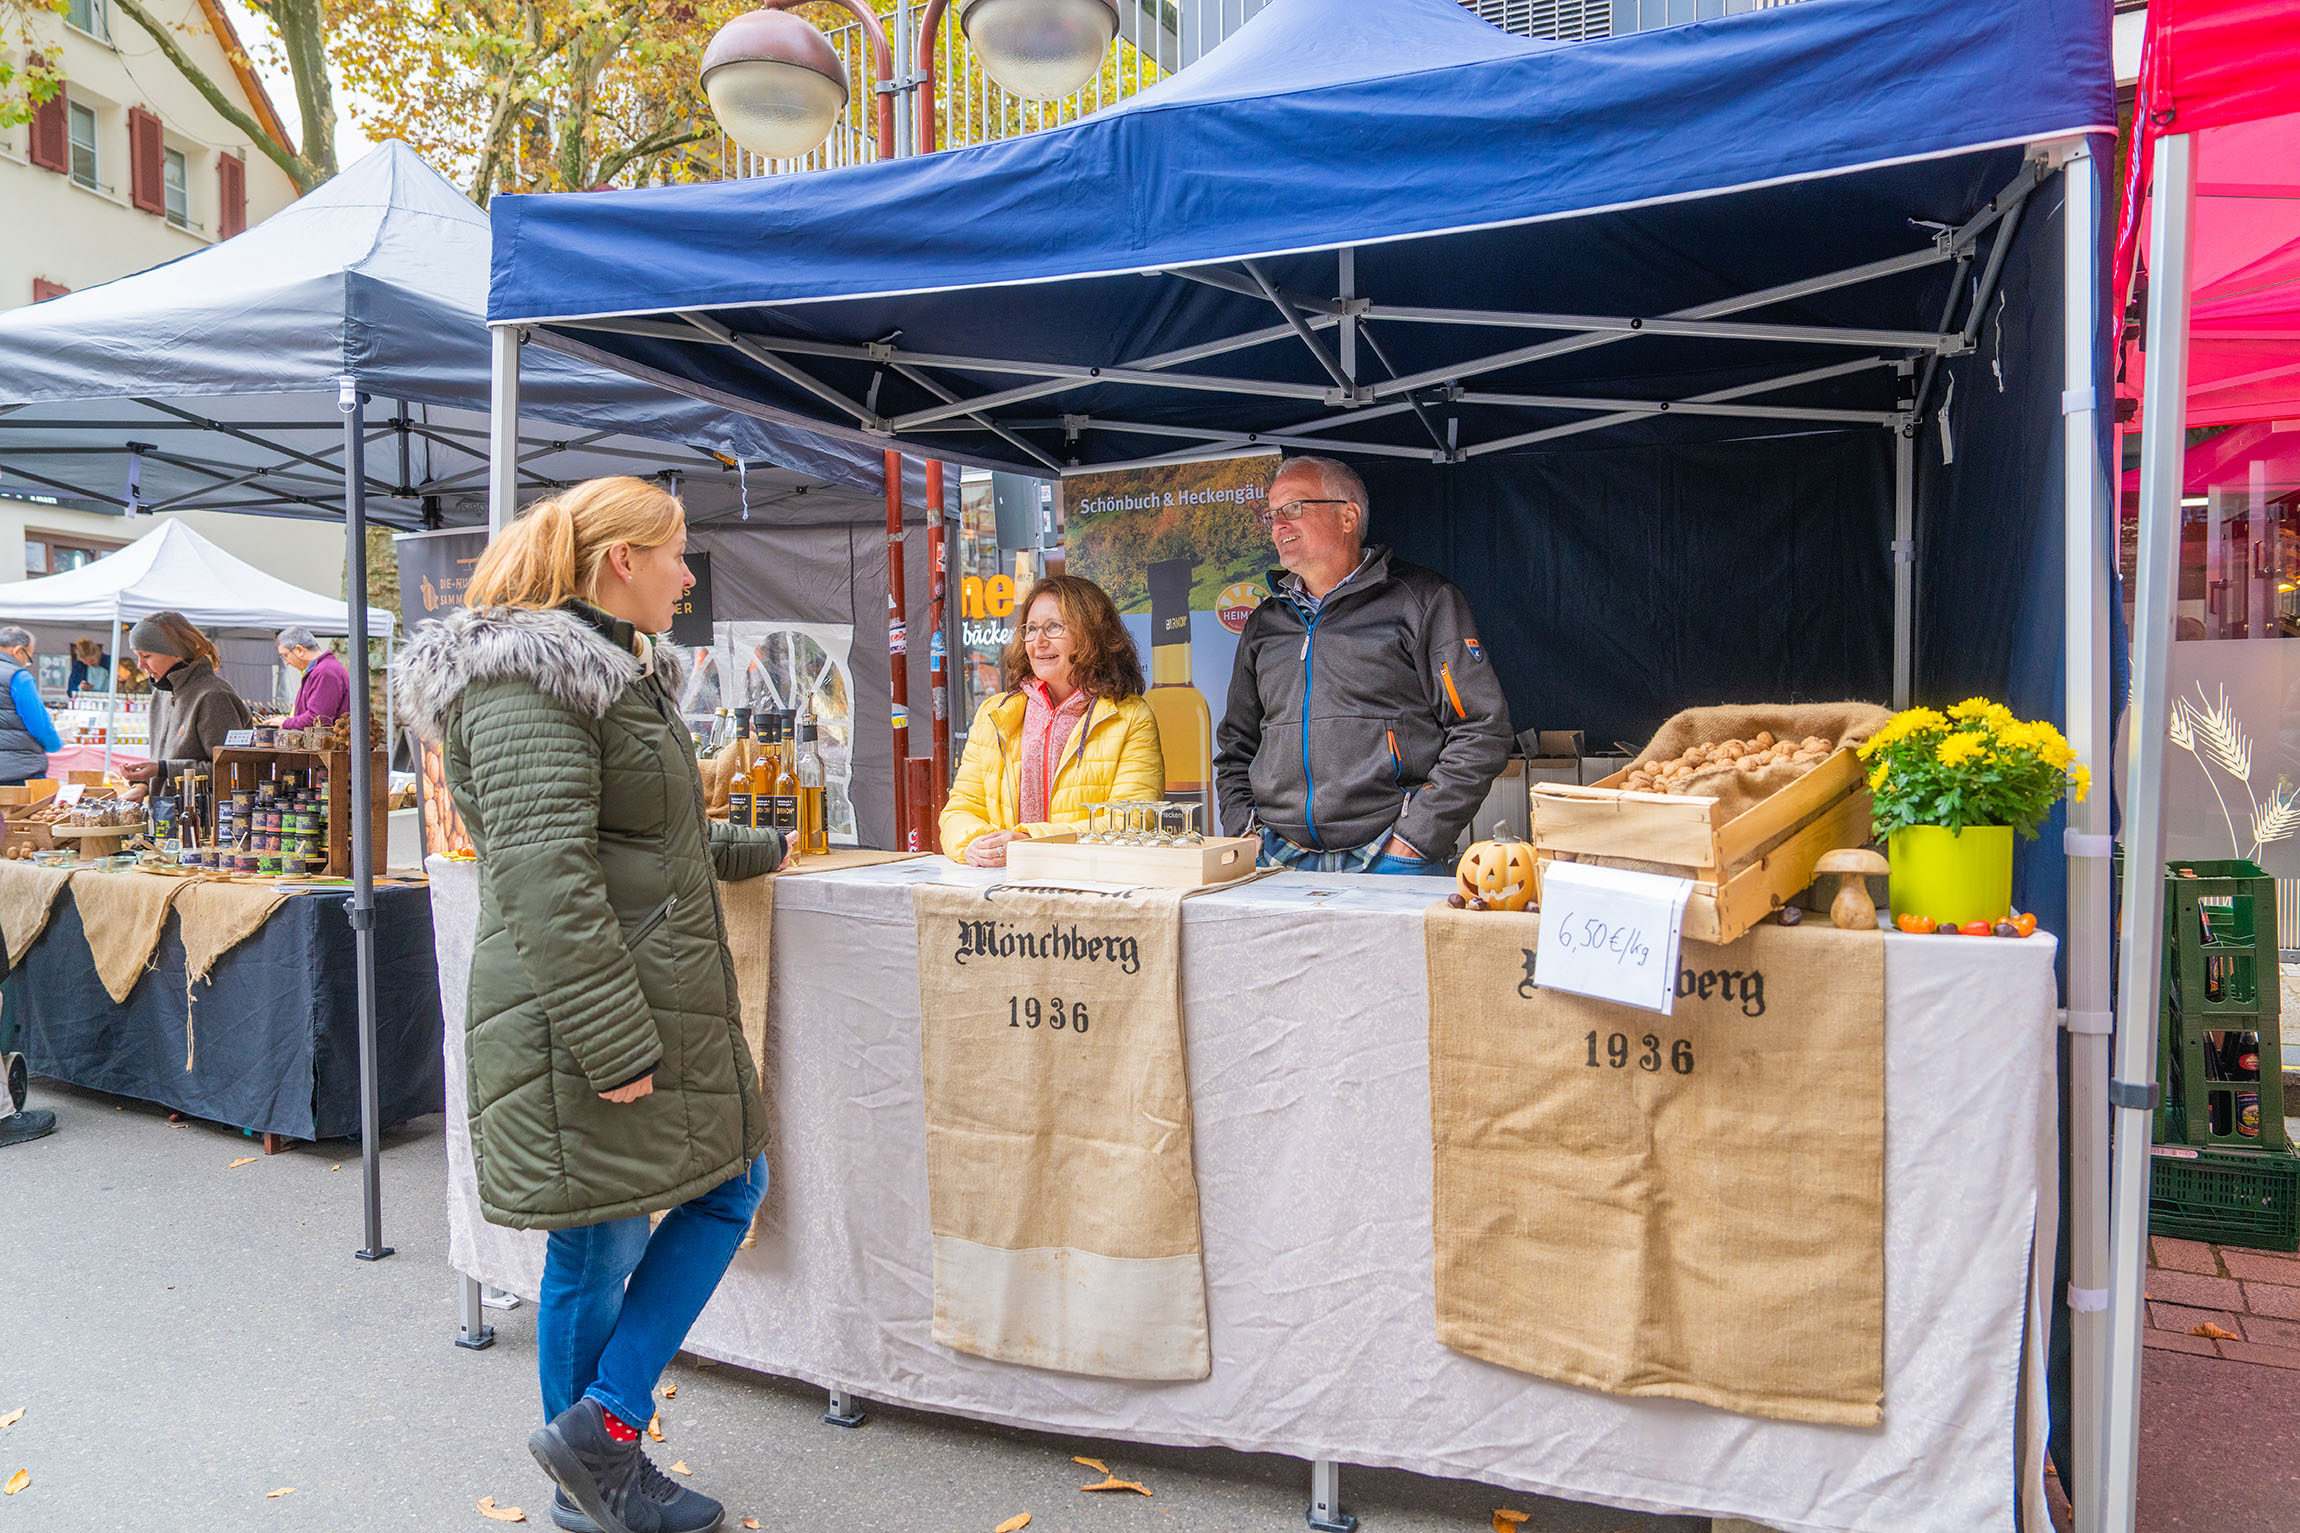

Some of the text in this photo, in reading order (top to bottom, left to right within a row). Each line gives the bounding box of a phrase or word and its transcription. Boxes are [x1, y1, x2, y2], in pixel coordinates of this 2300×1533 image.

[1080, 484, 1265, 514] Schönbuch & Heckengäu
[954, 918, 1141, 975] Mönchberg
[1008, 995, 1089, 1034] 1936
[1584, 1030, 1695, 1075] 1936
